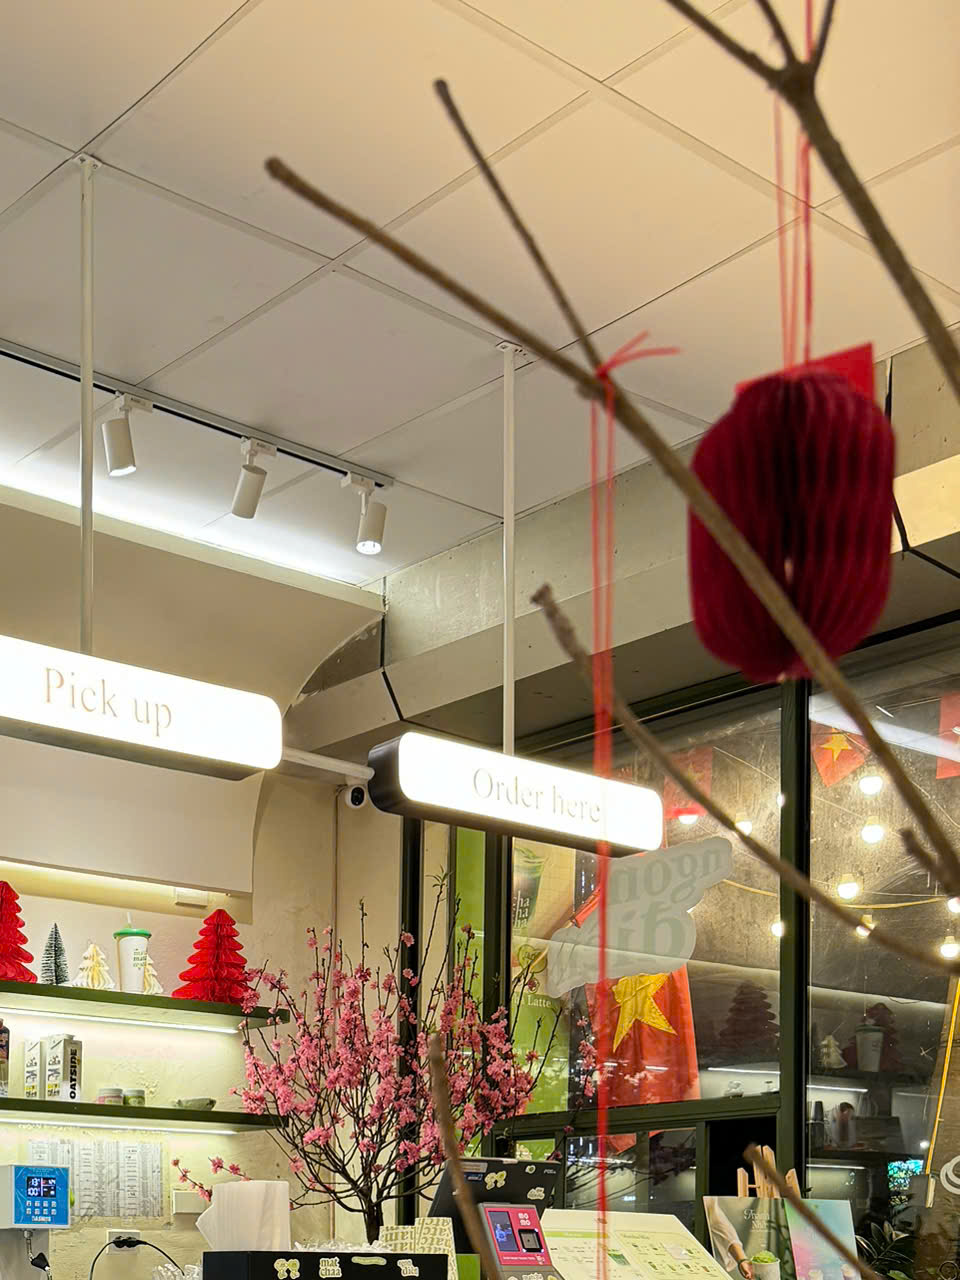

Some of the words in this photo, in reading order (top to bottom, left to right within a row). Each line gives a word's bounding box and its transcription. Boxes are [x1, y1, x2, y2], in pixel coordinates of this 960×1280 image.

[44, 667, 117, 718] Pick
[133, 698, 171, 737] up
[473, 767, 544, 809] Order
[552, 785, 600, 822] here
[527, 995, 551, 1008] Latte
[69, 1048, 78, 1100] OATSIDE
[320, 1267, 341, 1276] chaa
[321, 1258, 339, 1267] mat
